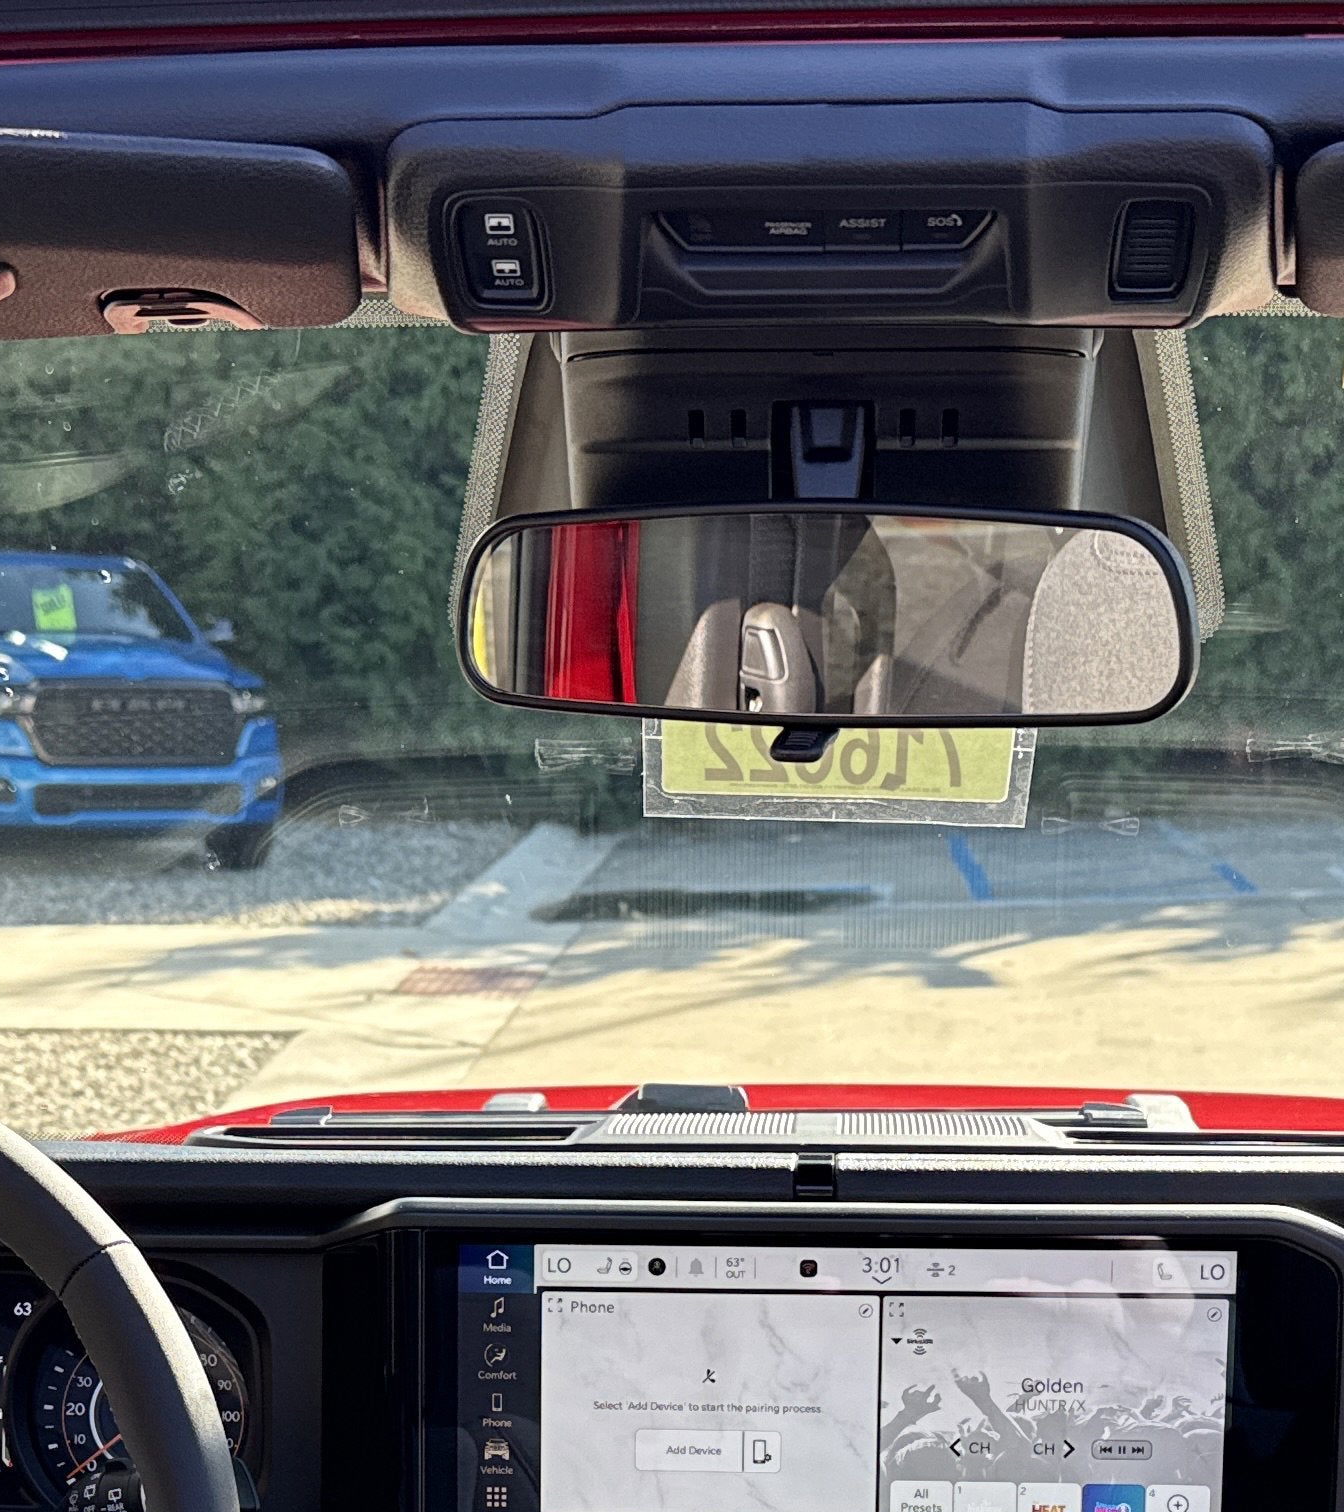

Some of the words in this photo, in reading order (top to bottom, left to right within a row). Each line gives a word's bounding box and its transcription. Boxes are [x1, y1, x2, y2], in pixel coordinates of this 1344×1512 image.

[839, 218, 886, 228] ASSIST
[928, 217, 953, 227] SOS
[487, 238, 518, 246] AUTO
[495, 279, 524, 287] AUTO
[548, 1257, 572, 1273] LO
[862, 1257, 901, 1273] 3:01
[726, 1270, 746, 1279] OUT
[948, 1265, 956, 1276] 2
[1200, 1264, 1225, 1281] LO
[484, 1276, 512, 1285] Home
[570, 1301, 615, 1313] Phone
[483, 1323, 512, 1333] Media
[478, 1371, 517, 1380] Comfort
[76, 1376, 93, 1388] 30
[217, 1380, 232, 1391] 90
[1021, 1378, 1084, 1393] Golden
[66, 1402, 86, 1416] 20
[593, 1401, 623, 1411] Select
[688, 1402, 699, 1411] to
[701, 1403, 724, 1412] start
[727, 1403, 743, 1412] the
[746, 1404, 779, 1414] pairing
[1015, 1400, 1087, 1412] HUNTR/X
[482, 1418, 513, 1428] Phone
[73, 1434, 86, 1445] 10
[666, 1446, 686, 1455] Add
[689, 1446, 722, 1455] Device
[969, 1442, 990, 1454] CH
[1033, 1443, 1055, 1456] CH
[87, 1459, 97, 1472] 0
[480, 1466, 514, 1475] Vehicle
[914, 1489, 928, 1499] All
[1019, 1486, 1027, 1495] 2
[1148, 1488, 1156, 1497] 4
[107, 1502, 124, 1512] REAR
